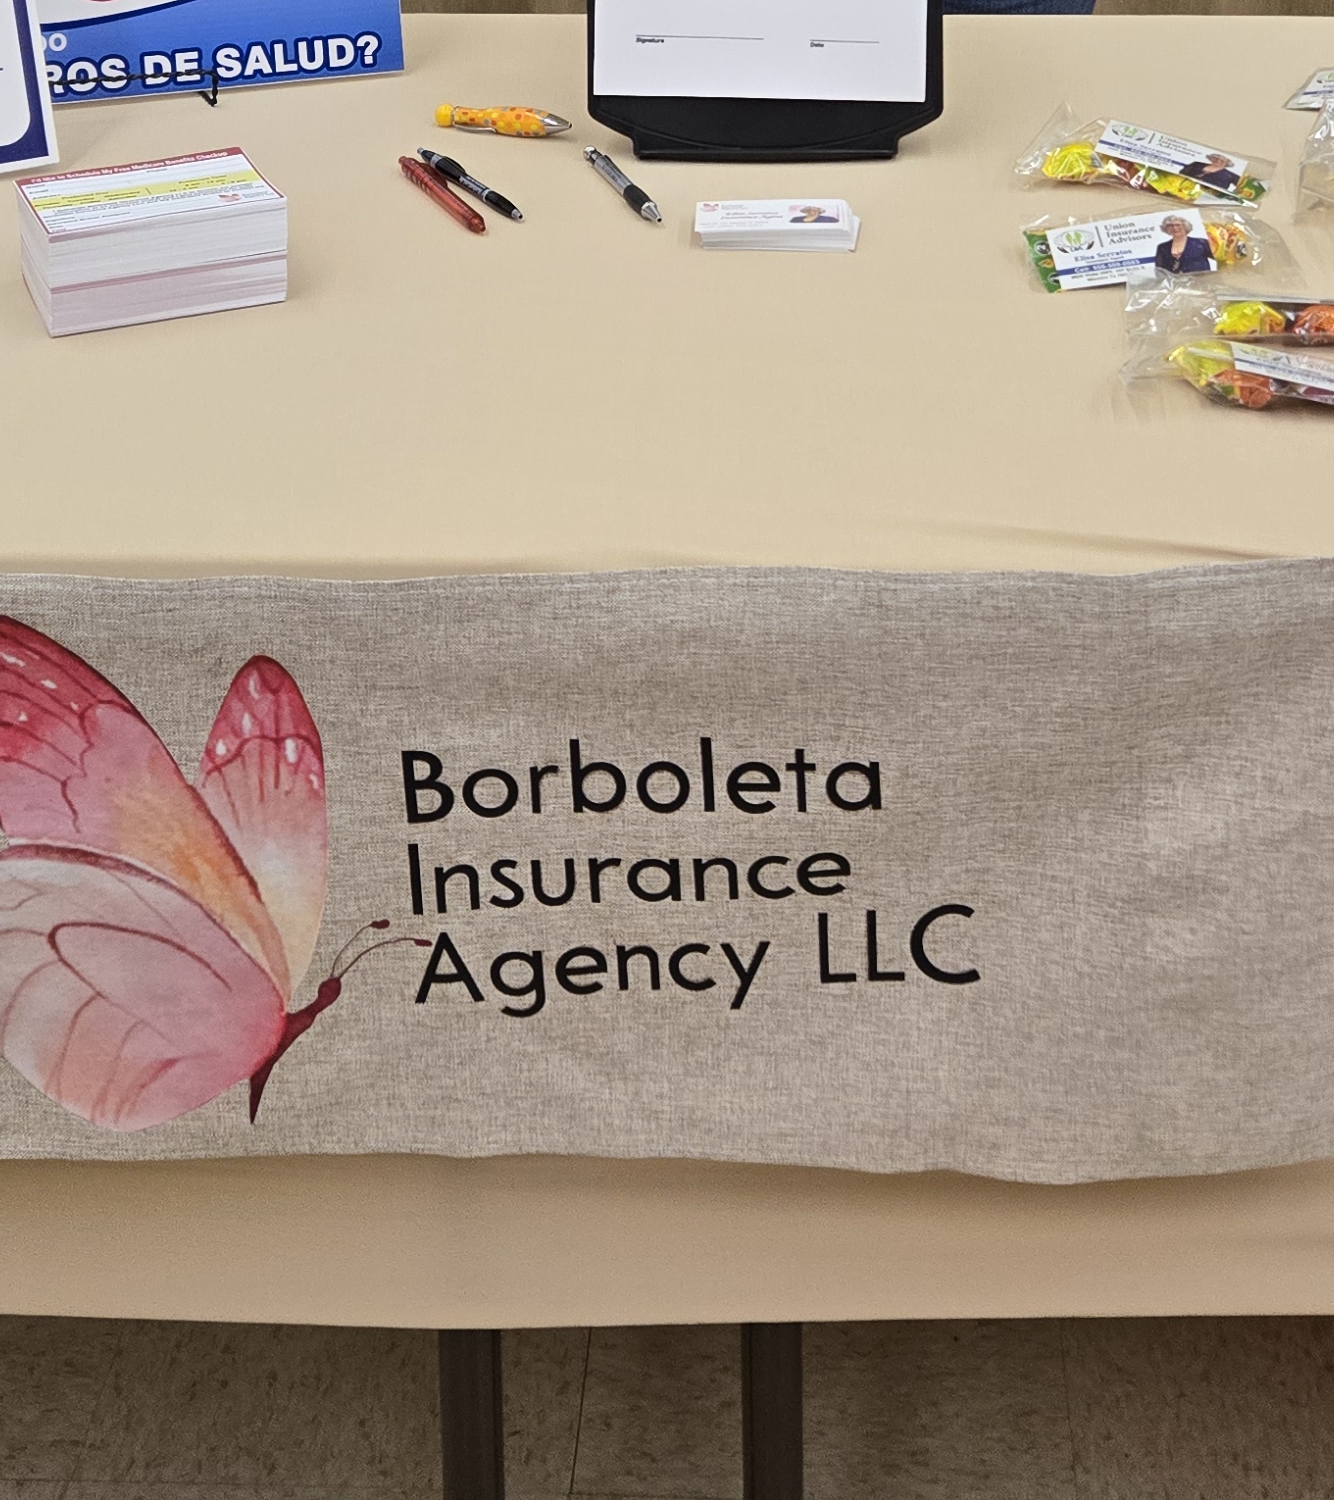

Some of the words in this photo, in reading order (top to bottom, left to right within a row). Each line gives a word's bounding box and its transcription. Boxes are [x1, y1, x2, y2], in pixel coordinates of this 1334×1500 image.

[143, 51, 201, 85] DE
[216, 34, 379, 79] SALUD?
[1104, 222, 1135, 231] Union
[1106, 226, 1155, 238] Insurance
[1109, 234, 1152, 245] Advisors
[399, 737, 884, 826] Borboleta
[405, 842, 852, 916] Insurance
[412, 931, 772, 1019] Agency
[815, 902, 983, 986] LLC
